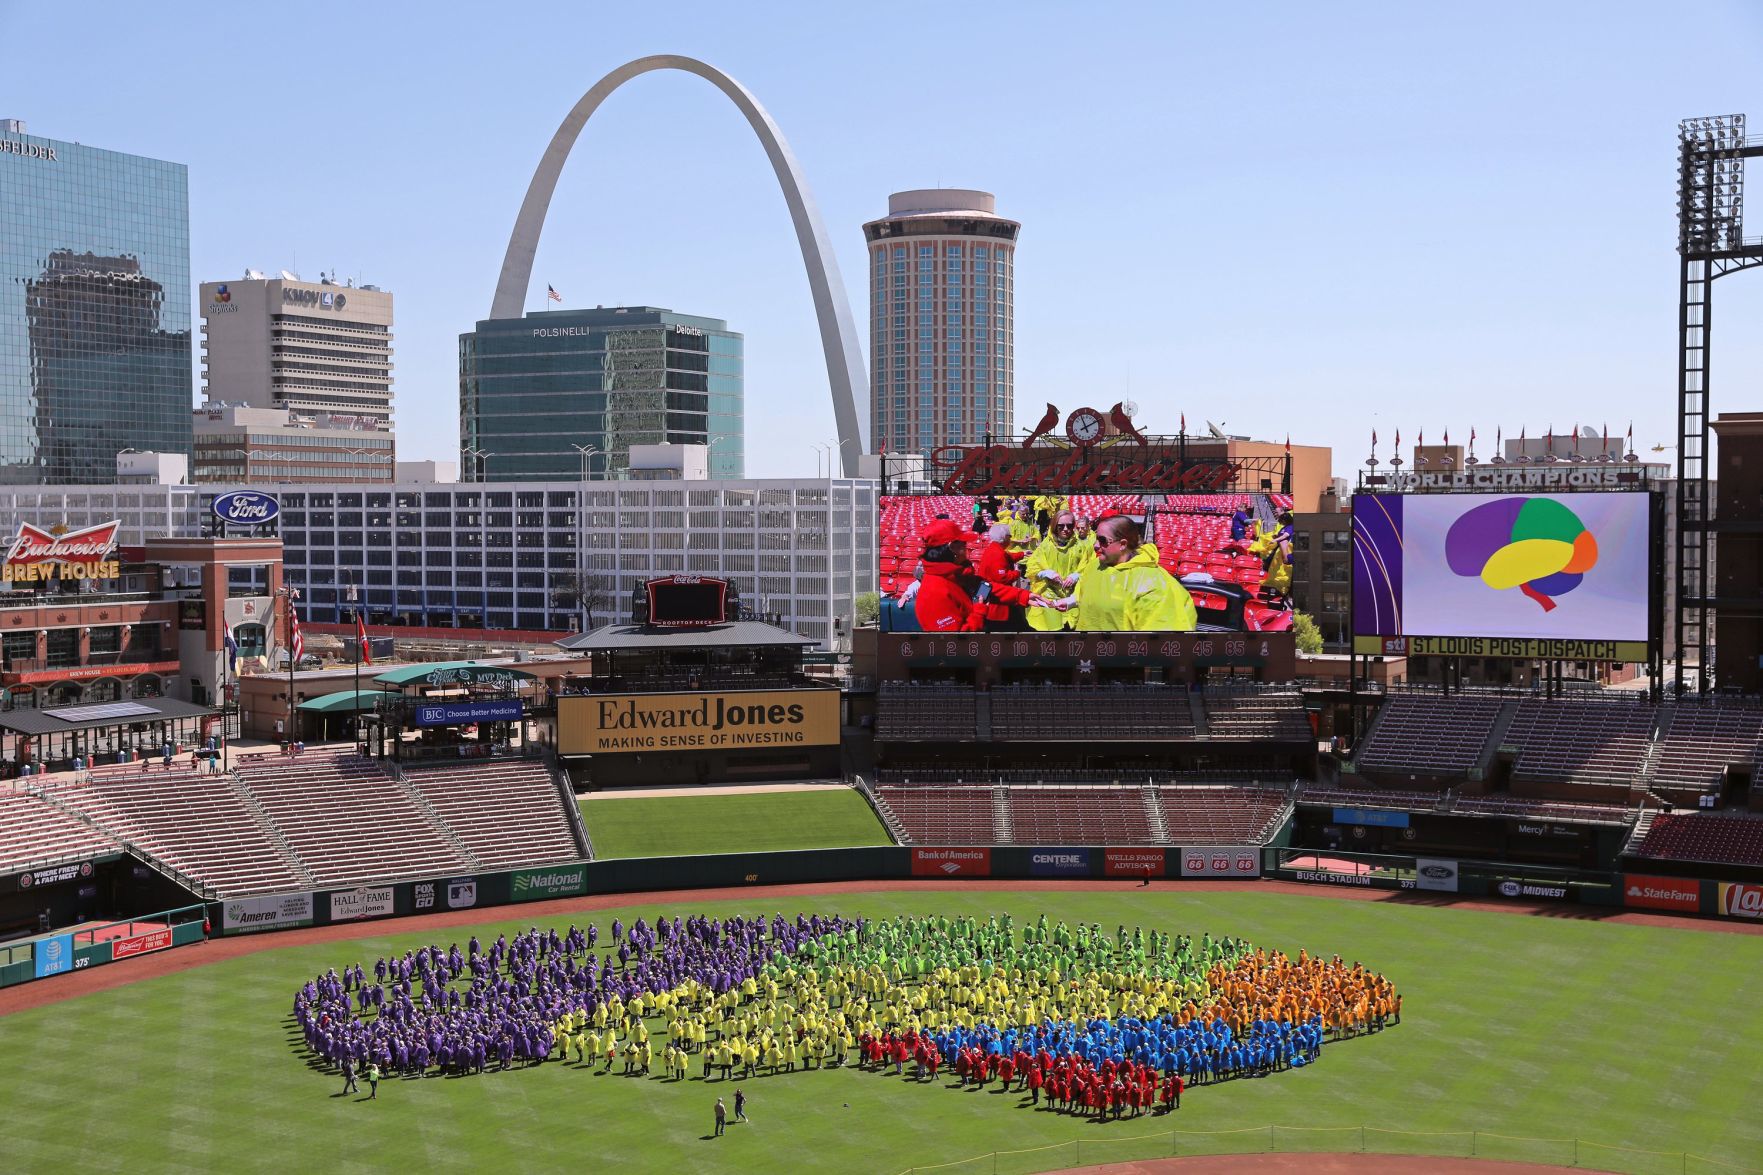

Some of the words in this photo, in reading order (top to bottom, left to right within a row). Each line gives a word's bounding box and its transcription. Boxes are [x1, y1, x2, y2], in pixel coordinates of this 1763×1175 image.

[283, 288, 319, 304] KMOV
[533, 326, 590, 338] POLSINELLI
[932, 445, 1242, 495] Budweiser
[1384, 472, 1467, 488] WORLD
[1474, 471, 1618, 487] CHAMPIONS
[229, 495, 268, 517] Ford
[2, 535, 118, 559] Budweiser
[2, 562, 55, 582] BREW
[60, 560, 120, 580] HOUSE
[928, 641, 935, 656] 1
[946, 641, 957, 656] 2
[969, 641, 979, 656] 6
[991, 641, 1001, 656] 9
[1013, 641, 1029, 656] 10
[1040, 641, 1056, 656] 14
[1068, 641, 1084, 656] 17
[1096, 641, 1117, 656] 20
[1128, 641, 1148, 656] 24
[1160, 641, 1181, 656] 42
[1192, 641, 1213, 656] 45
[1225, 641, 1245, 656] 85
[1413, 637, 1435, 654] ST.
[1439, 638, 1483, 655] LOUIS
[1489, 638, 1617, 658] POST-DISPATCH
[477, 674, 495, 682] MVP
[496, 672, 513, 680] Deck
[425, 710, 442, 719] BJC
[596, 698, 709, 730] Edward
[712, 698, 804, 731] Jones
[599, 736, 655, 748] MAKING
[659, 734, 704, 746] SENSE
[710, 734, 728, 745] OF
[732, 732, 804, 744] INVESTING
[1518, 824, 1544, 835] Mercy
[918, 850, 939, 859] Bank
[940, 850, 950, 859] of
[950, 851, 984, 859] America
[1032, 854, 1080, 863] CENTENE
[1188, 860, 1202, 869] 66
[1213, 860, 1227, 869] 66
[1238, 860, 1252, 869] 66
[33, 868, 57, 879] WHERE
[58, 865, 80, 874] FRESH
[41, 875, 58, 884] FAST
[58, 871, 77, 881] MEET
[1297, 871, 1327, 882] BUSCH
[1328, 874, 1371, 885] STADIUM
[1425, 867, 1449, 878] Ford
[530, 871, 582, 888] National
[1400, 880, 1415, 889] 375'
[415, 883, 435, 895] FOX
[1523, 886, 1566, 898] MIDWEST
[1643, 887, 1670, 899] State
[1671, 889, 1697, 901] Farm
[334, 895, 357, 906] HALL
[366, 892, 391, 902] FAME
[416, 897, 434, 908] GO
[1730, 884, 1763, 914] La
[340, 905, 364, 915] Edward
[364, 905, 385, 913] Jones
[240, 911, 277, 924] Ameren
[145, 934, 156, 943] THIS
[156, 932, 169, 941] BUD'S
[145, 941, 154, 949] FOR
[154, 940, 165, 948] YOU.
[44, 961, 63, 973] AT&T
[75, 957, 90, 968] 375'
